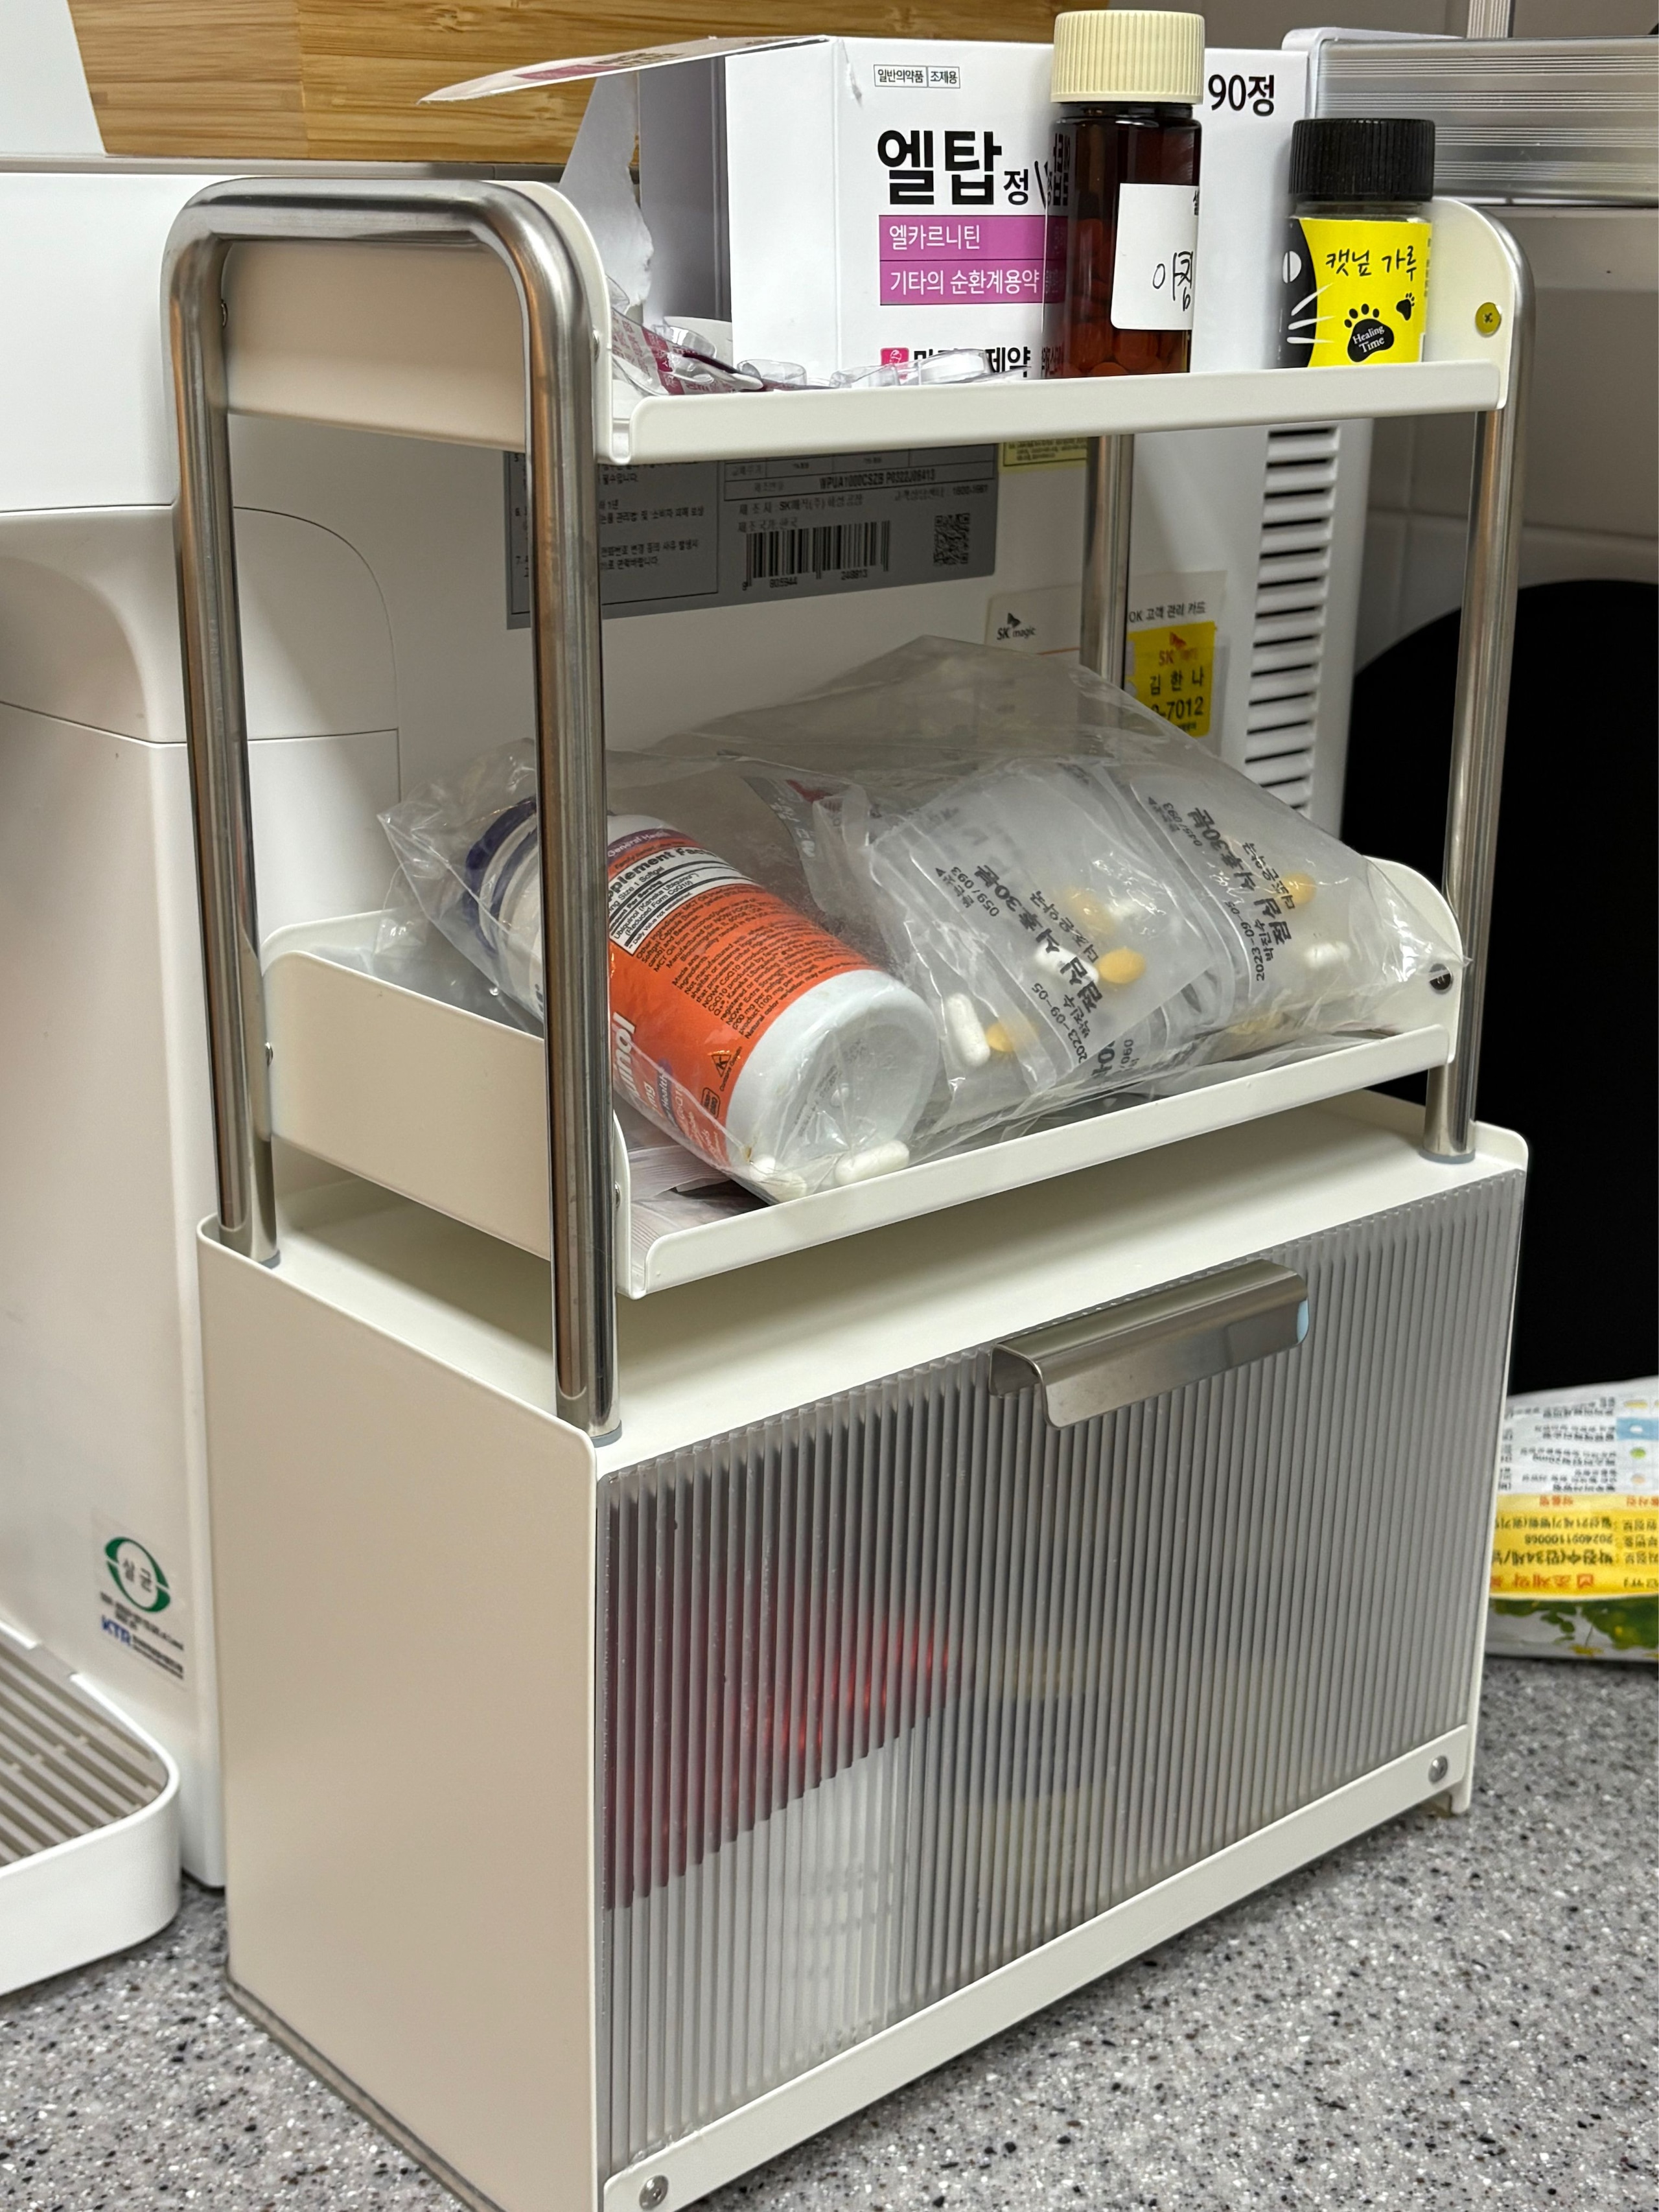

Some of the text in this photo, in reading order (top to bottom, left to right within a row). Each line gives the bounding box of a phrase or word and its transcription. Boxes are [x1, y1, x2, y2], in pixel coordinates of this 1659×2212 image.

[877, 69, 958, 84] 일반의약품 조제용
[1207, 74, 1275, 117] 90정
[889, 224, 980, 250] 엘카르니틴
[890, 268, 1039, 296] 기타의 순환계용약
[1381, 246, 1417, 281] 가루
[1352, 325, 1386, 345] Healing
[1358, 336, 1386, 354] Time
[997, 626, 1037, 640] SK magic
[1129, 611, 1143, 623] OK
[1146, 606, 1164, 620] 고객
[604, 850, 673, 902] pplement
[618, 885, 634, 900] Size
[638, 864, 664, 883] Softgel
[949, 864, 1001, 918] 059/093
[1187, 808, 1292, 946] 점심 식후30분
[612, 909, 641, 940] Ubiquinol
[638, 888, 665, 912] (Kaneka
[623, 905, 653, 936] (Reduced
[651, 893, 668, 908] Form
[626, 897, 639, 909] Per
[631, 930, 645, 944] Daily
[643, 917, 657, 931] Value
[634, 939, 653, 959] Other
[649, 909, 684, 941] Ingredients:
[682, 899, 698, 912] MCT
[640, 939, 662, 964] Softgel
[658, 918, 683, 942] Capsule
[646, 913, 701, 967] carob] and Beeswax.
[665, 927, 705, 969] Manufactured
[703, 921, 713, 930] for
[679, 924, 724, 962] Bloomingdale,
[972, 860, 1104, 1014] 점심 식후30분
[1224, 900, 1265, 981] 2023-09-05
[1253, 919, 1275, 961] 박진수
[652, 955, 667, 972] MCT
[665, 944, 677, 956] Oil
[675, 931, 690, 946] from
[671, 965, 689, 985] Made
[686, 953, 699, 967] and
[718, 922, 739, 939] tested
[676, 952, 710, 990] ingredients.
[684, 980, 697, 994] Not
[693, 942, 734, 982] manufactured
[689, 972, 712, 999] shellfish
[717, 946, 740, 967] sesame
[718, 963, 741, 986] CoQ10
[739, 944, 768, 966] products
[695, 988, 708, 1003] that
[706, 959, 735, 990] processes
[733, 946, 750, 962] other
[706, 987, 728, 1012] CoQ10
[726, 960, 756, 990] produced
[718, 987, 748, 1021] registered
[752, 960, 780, 983] pending
[726, 976, 749, 999] Kaneka
[743, 986, 760, 1004] Extra
[758, 964, 786, 989] Strength
[730, 1013, 745, 1029] (200
[743, 1003, 756, 1016] mg
[752, 991, 765, 1004] per
[736, 1007, 761, 1034] product
[758, 994, 773, 1009] (100
[771, 984, 784, 996] mg
[782, 977, 795, 988] per
[743, 1014, 766, 1039] Natural
[763, 999, 780, 1016] color
[778, 978, 804, 1001] variation
[1028, 980, 1091, 1064] 2023-09-05
[1058, 992, 1095, 1038] 박진수
[715, 1055, 728, 1070] K
